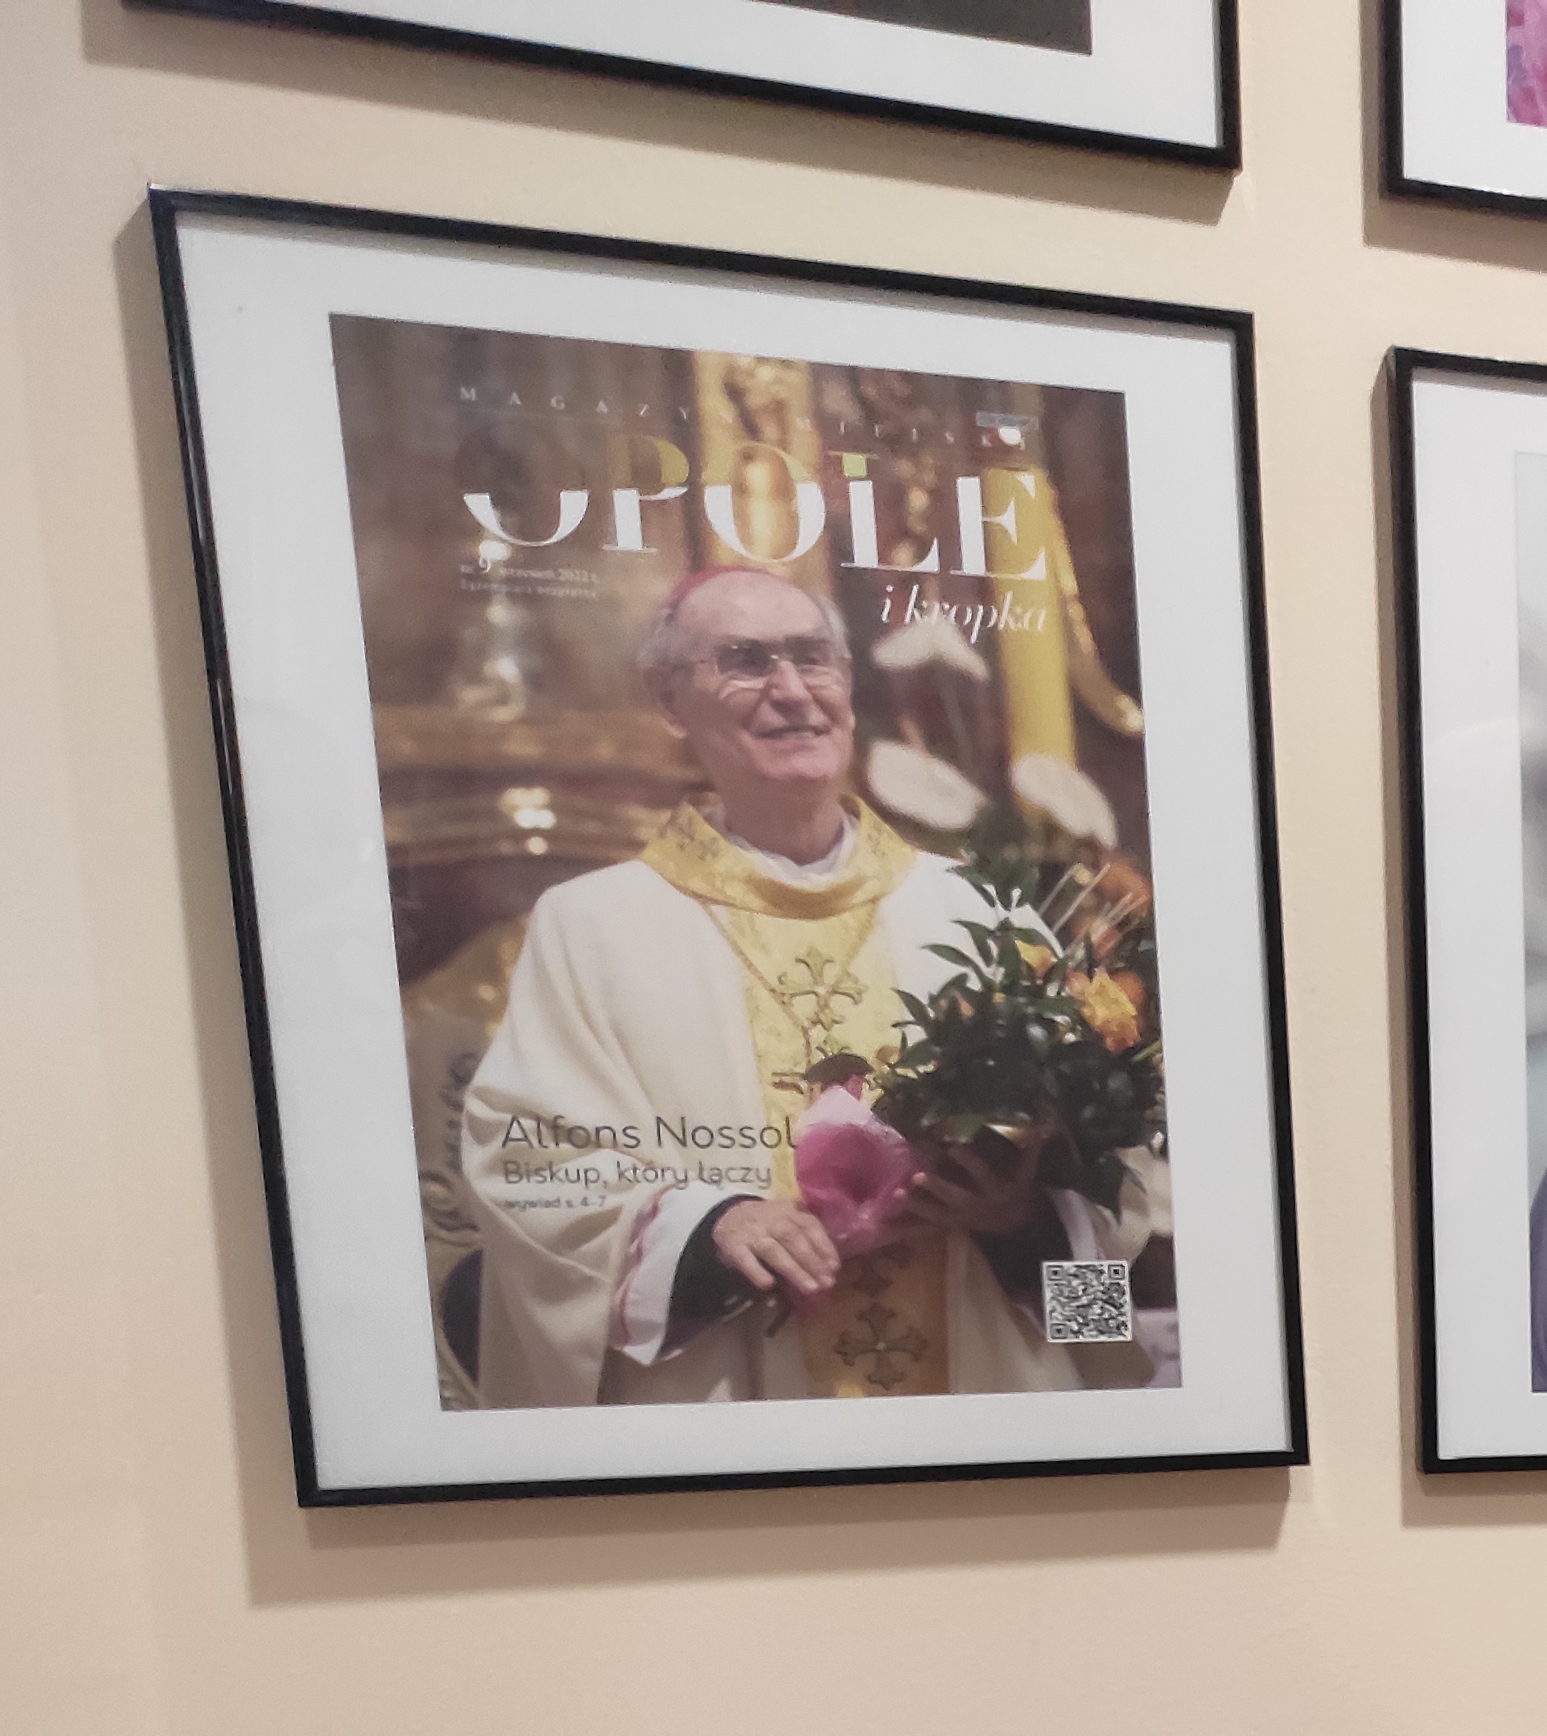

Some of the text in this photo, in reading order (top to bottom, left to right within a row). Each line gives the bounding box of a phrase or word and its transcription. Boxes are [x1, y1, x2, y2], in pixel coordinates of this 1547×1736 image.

[455, 432, 1048, 582] OPOLE
[903, 582, 1047, 645] kropka
[501, 1114, 797, 1150] Alfons Nossol
[503, 1160, 609, 1189] Biskup,
[616, 1160, 689, 1190] który
